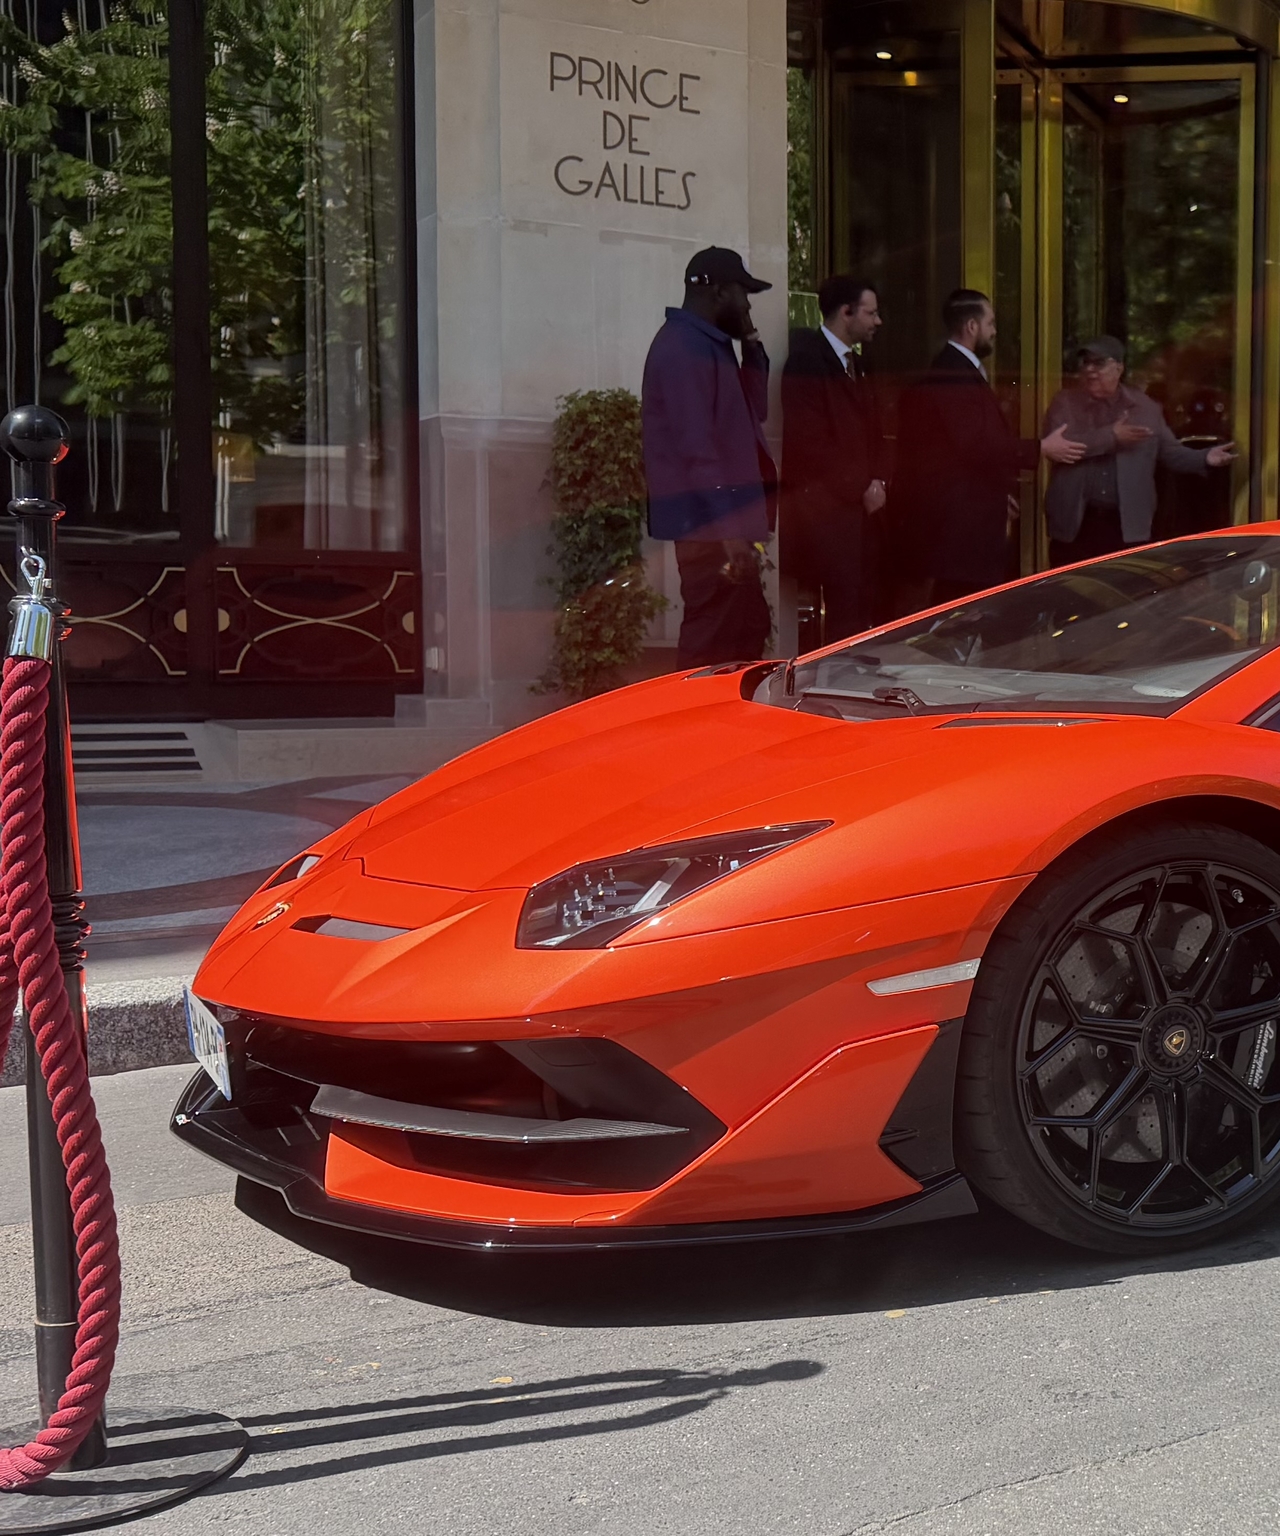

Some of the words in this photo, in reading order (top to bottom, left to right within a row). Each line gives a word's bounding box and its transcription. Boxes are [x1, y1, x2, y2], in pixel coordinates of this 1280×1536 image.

[550, 51, 701, 115] PRINCE
[602, 110, 650, 156] DE
[554, 155, 696, 210] GALLES
[1253, 1021, 1274, 1089] Lamborghini
